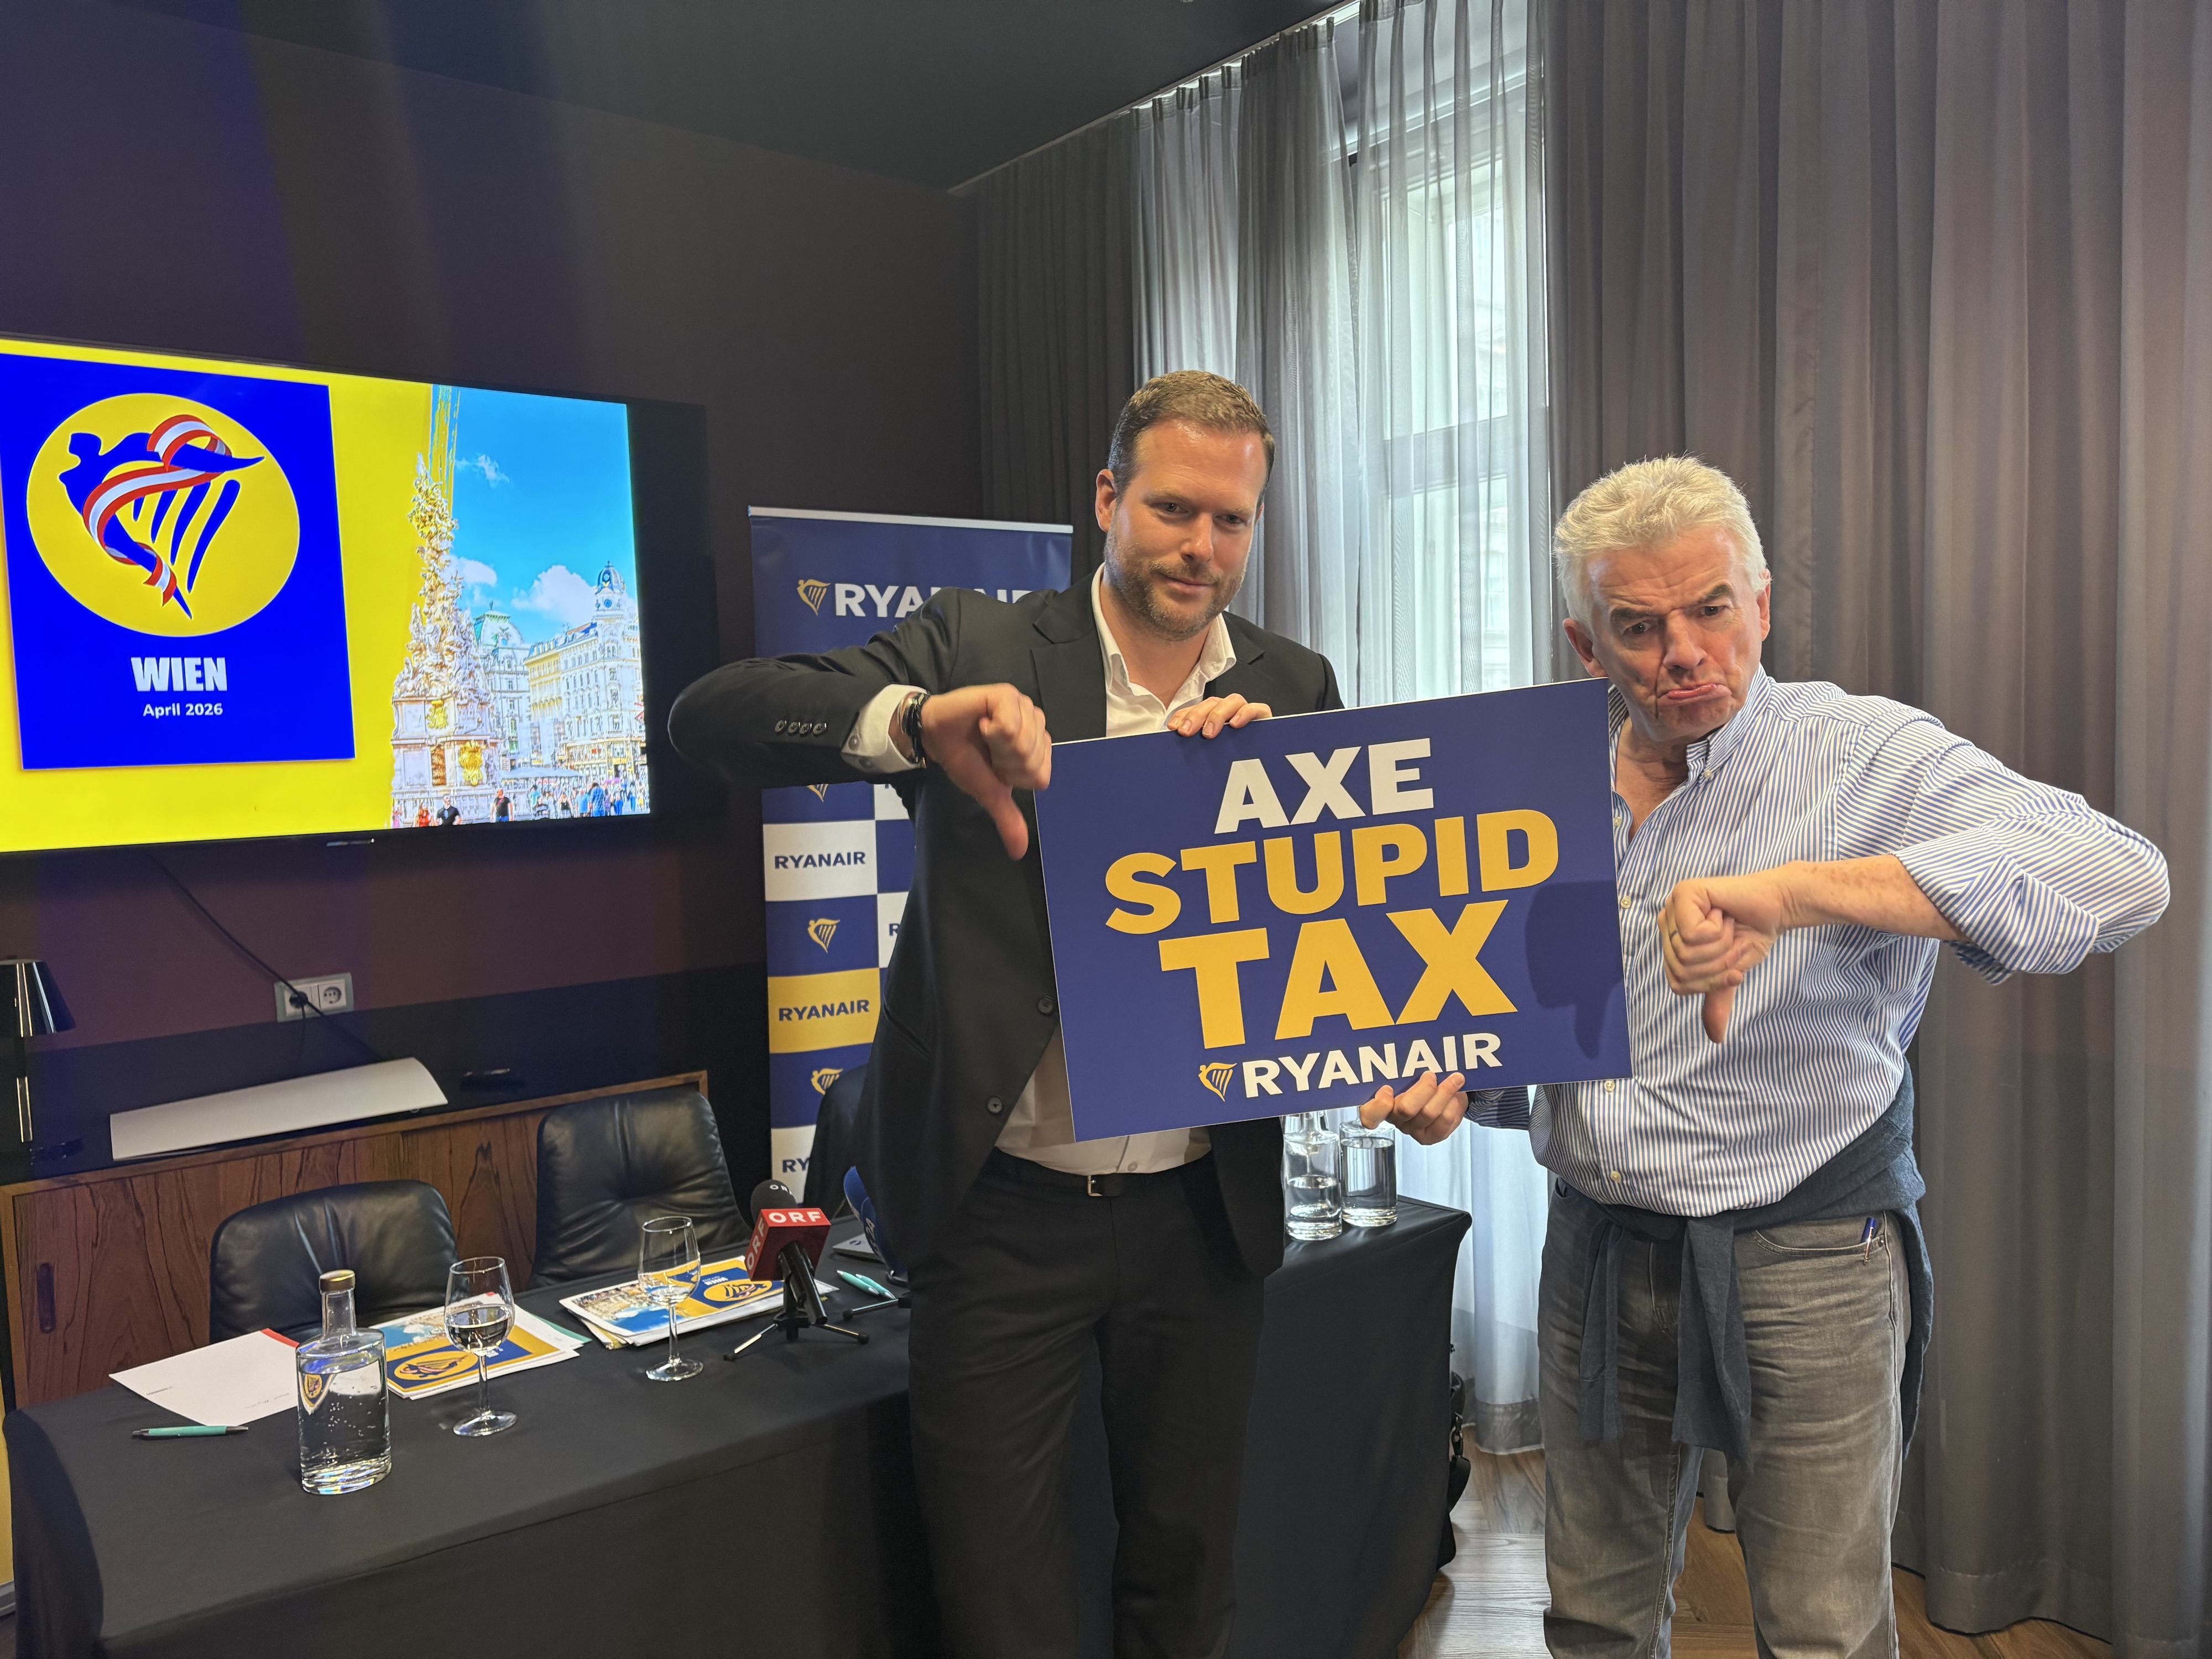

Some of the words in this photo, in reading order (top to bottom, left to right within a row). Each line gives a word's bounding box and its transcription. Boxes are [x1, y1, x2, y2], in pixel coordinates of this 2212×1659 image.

[131, 657, 227, 691] WIEN
[143, 703, 180, 719] April
[185, 703, 223, 716] 2026
[1214, 738, 1434, 834] AXE
[774, 851, 866, 869] RYANAIR
[1105, 808, 1559, 935] STUPID
[1159, 900, 1518, 1049] TAX
[779, 999, 870, 1021] RYANAIR
[1243, 1032, 1503, 1098] RYANAIR
[769, 1211, 821, 1223] ORF
[747, 1218, 764, 1270] ORF
